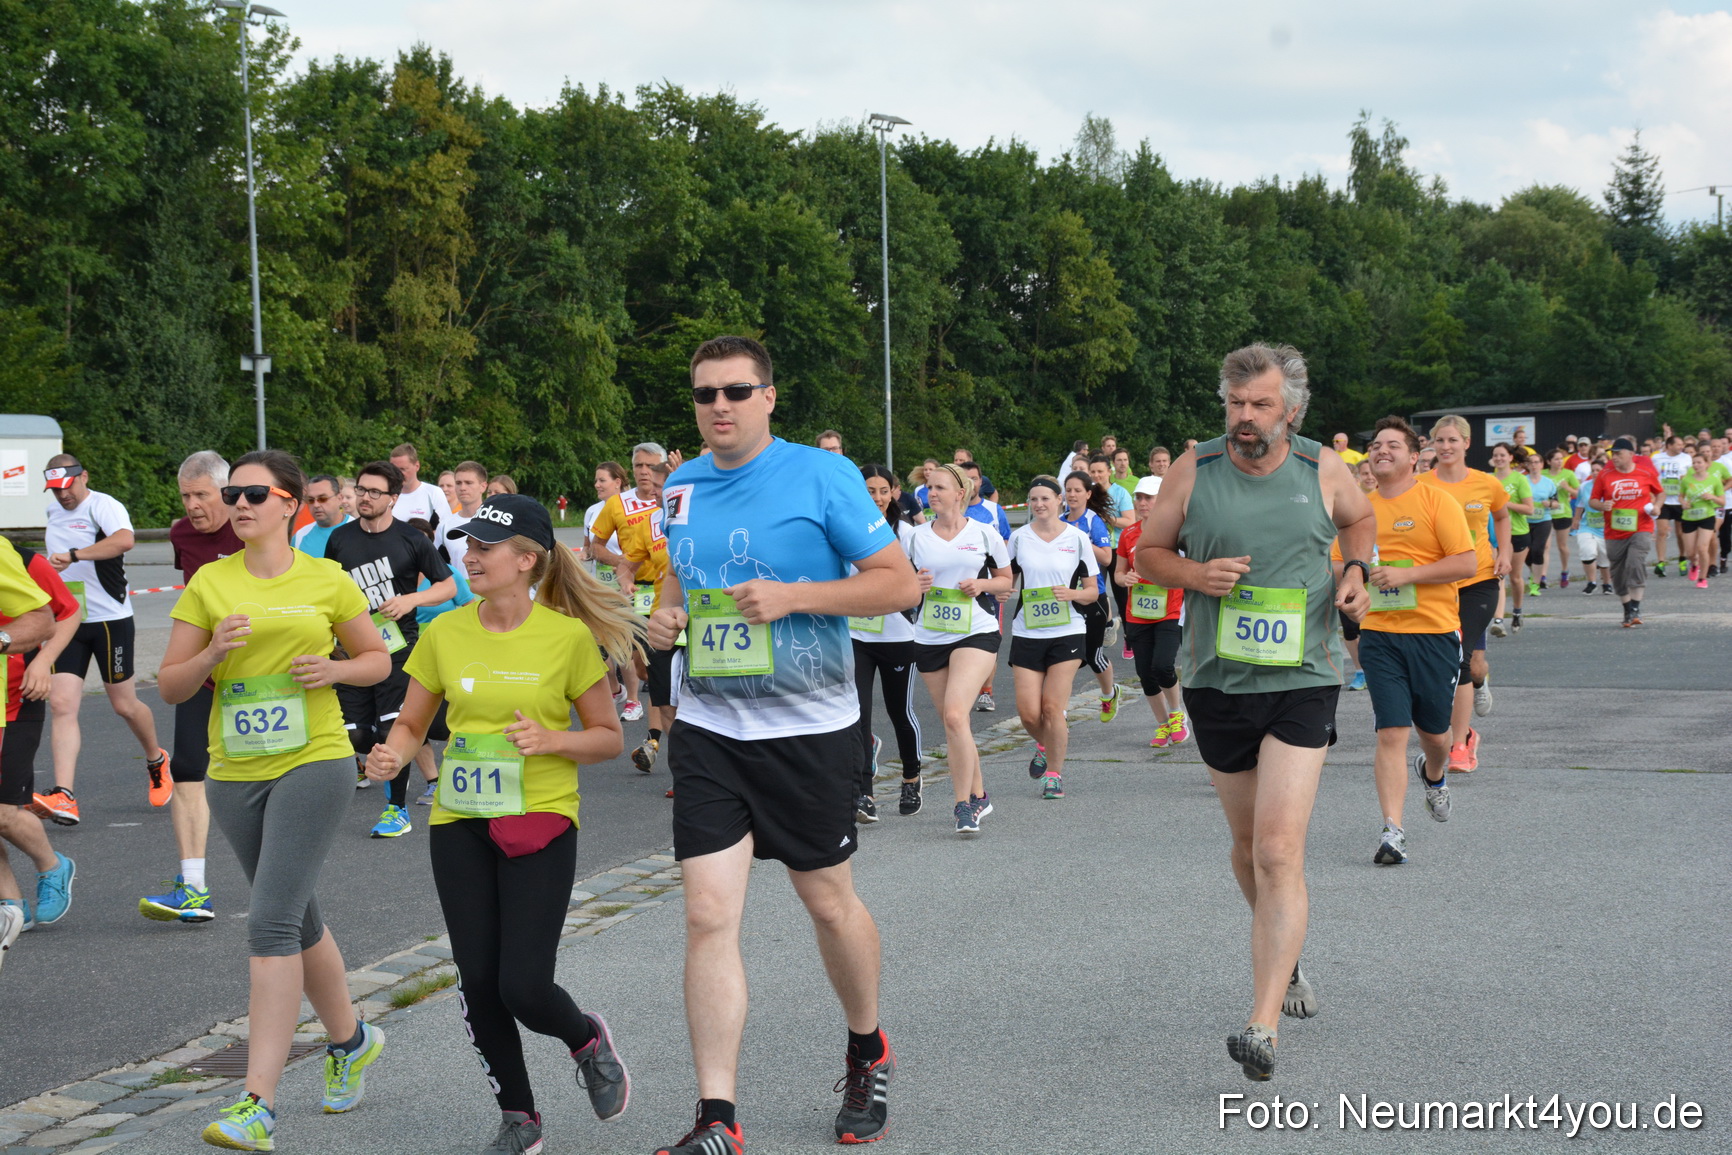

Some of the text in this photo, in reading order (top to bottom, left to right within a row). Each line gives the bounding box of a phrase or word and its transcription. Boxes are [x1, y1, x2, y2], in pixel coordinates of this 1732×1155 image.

[1616, 517, 1632, 525] 425
[1032, 602, 1060, 617] 386
[1137, 597, 1159, 610] 428
[932, 604, 961, 621] 389
[701, 622, 752, 652] 473
[1235, 615, 1288, 644] 500
[1241, 645, 1255, 653] Peter
[234, 705, 290, 736] 632
[452, 766, 501, 794] 611
